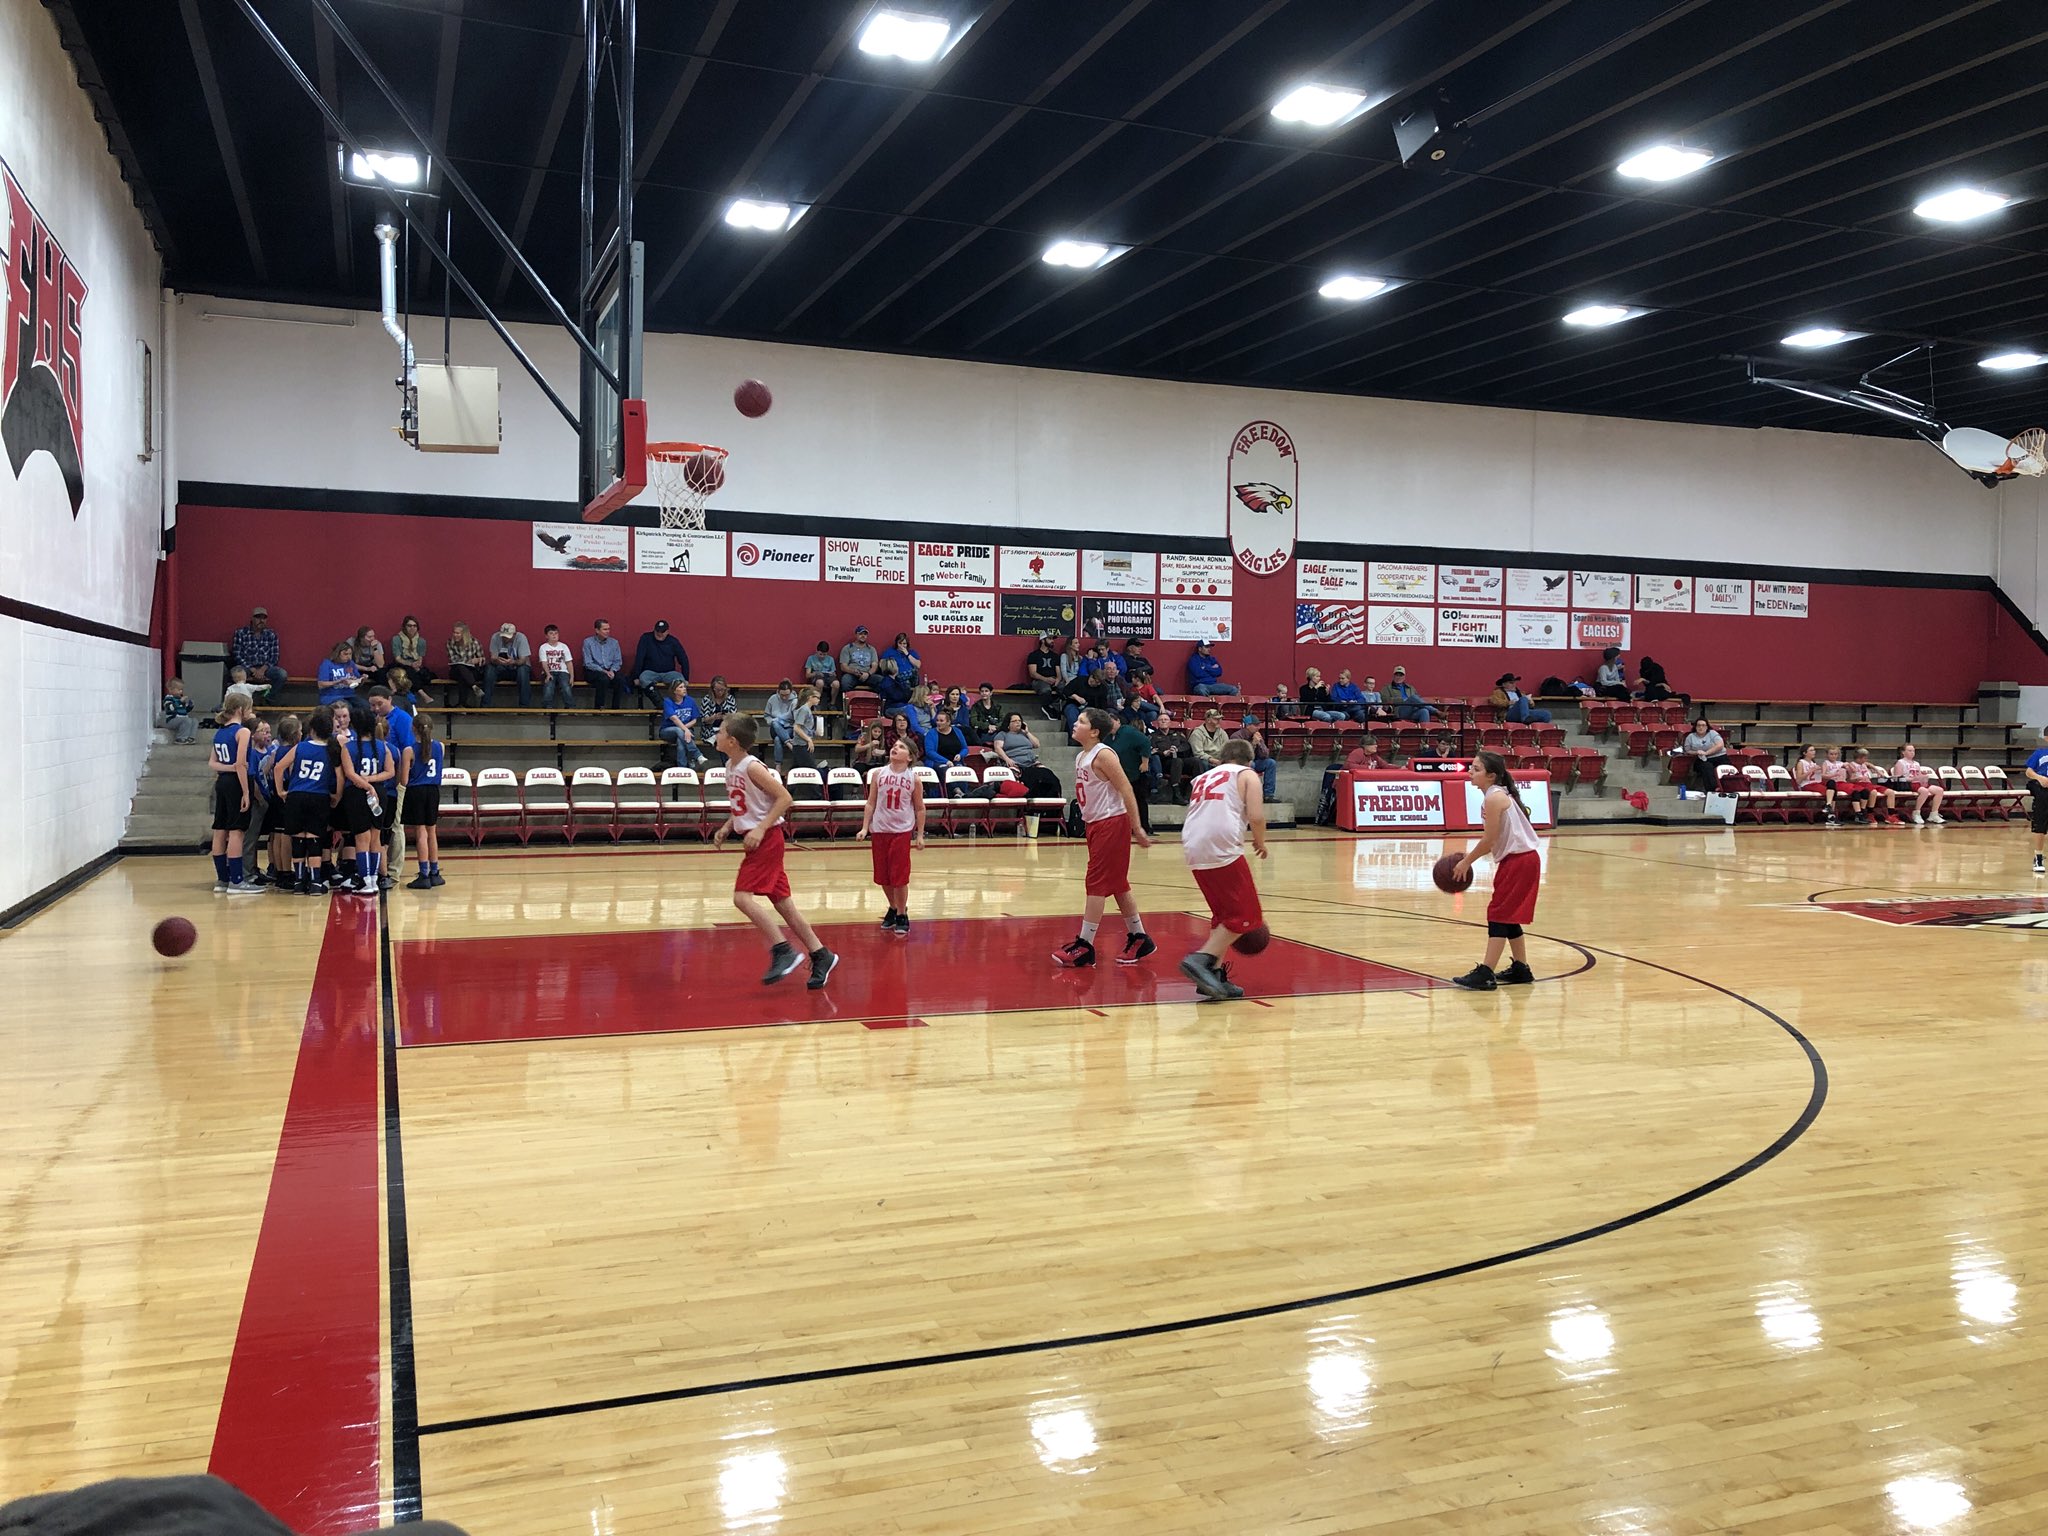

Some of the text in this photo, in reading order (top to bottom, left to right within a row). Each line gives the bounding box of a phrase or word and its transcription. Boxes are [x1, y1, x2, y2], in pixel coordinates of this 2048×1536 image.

[1236, 425, 1293, 458] FREEDOM
[828, 540, 859, 553] SHOW
[918, 544, 990, 559] EAGLE PRIDE
[762, 549, 815, 563] Pioneer
[849, 555, 883, 568] EAGLE
[1238, 547, 1287, 573] EAGLES
[939, 560, 966, 569] Catch It
[1303, 564, 1327, 574] EAGLE
[876, 570, 905, 582] PRIDE
[921, 571, 987, 585] The Weber Family
[1320, 576, 1344, 587] EAGLE
[1704, 584, 1727, 593] GO GET
[1757, 584, 1804, 595] PLAY WITH PRIDE
[919, 600, 948, 608] O-BAR
[977, 601, 991, 609] LLC
[1108, 600, 1152, 615] HUGHES
[1755, 599, 1807, 612] The EDEN Family
[1108, 615, 1152, 624] PHOTOGRAPHY
[1328, 611, 1355, 619] BLESS
[1381, 614, 1395, 628] CAMP
[1403, 610, 1425, 633] HOUSTON
[1442, 610, 1461, 620] GO!
[1608, 615, 1629, 624] Heights
[928, 624, 981, 633] SUPERIOR
[1107, 626, 1152, 635] 580-621-3333
[1312, 623, 1351, 631] AMERICA
[1452, 622, 1487, 632] FIGHT!
[1583, 625, 1620, 638] EAGLES!
[1474, 635, 1498, 644] WIN!
[214, 743, 231, 762] 50
[298, 759, 325, 781] 52
[360, 758, 378, 776] 31
[426, 758, 437, 778] 3
[879, 775, 911, 790] EAGLES
[1190, 771, 1230, 802] 42
[886, 788, 901, 809] 11
[1358, 795, 1441, 812] FREEDOM
